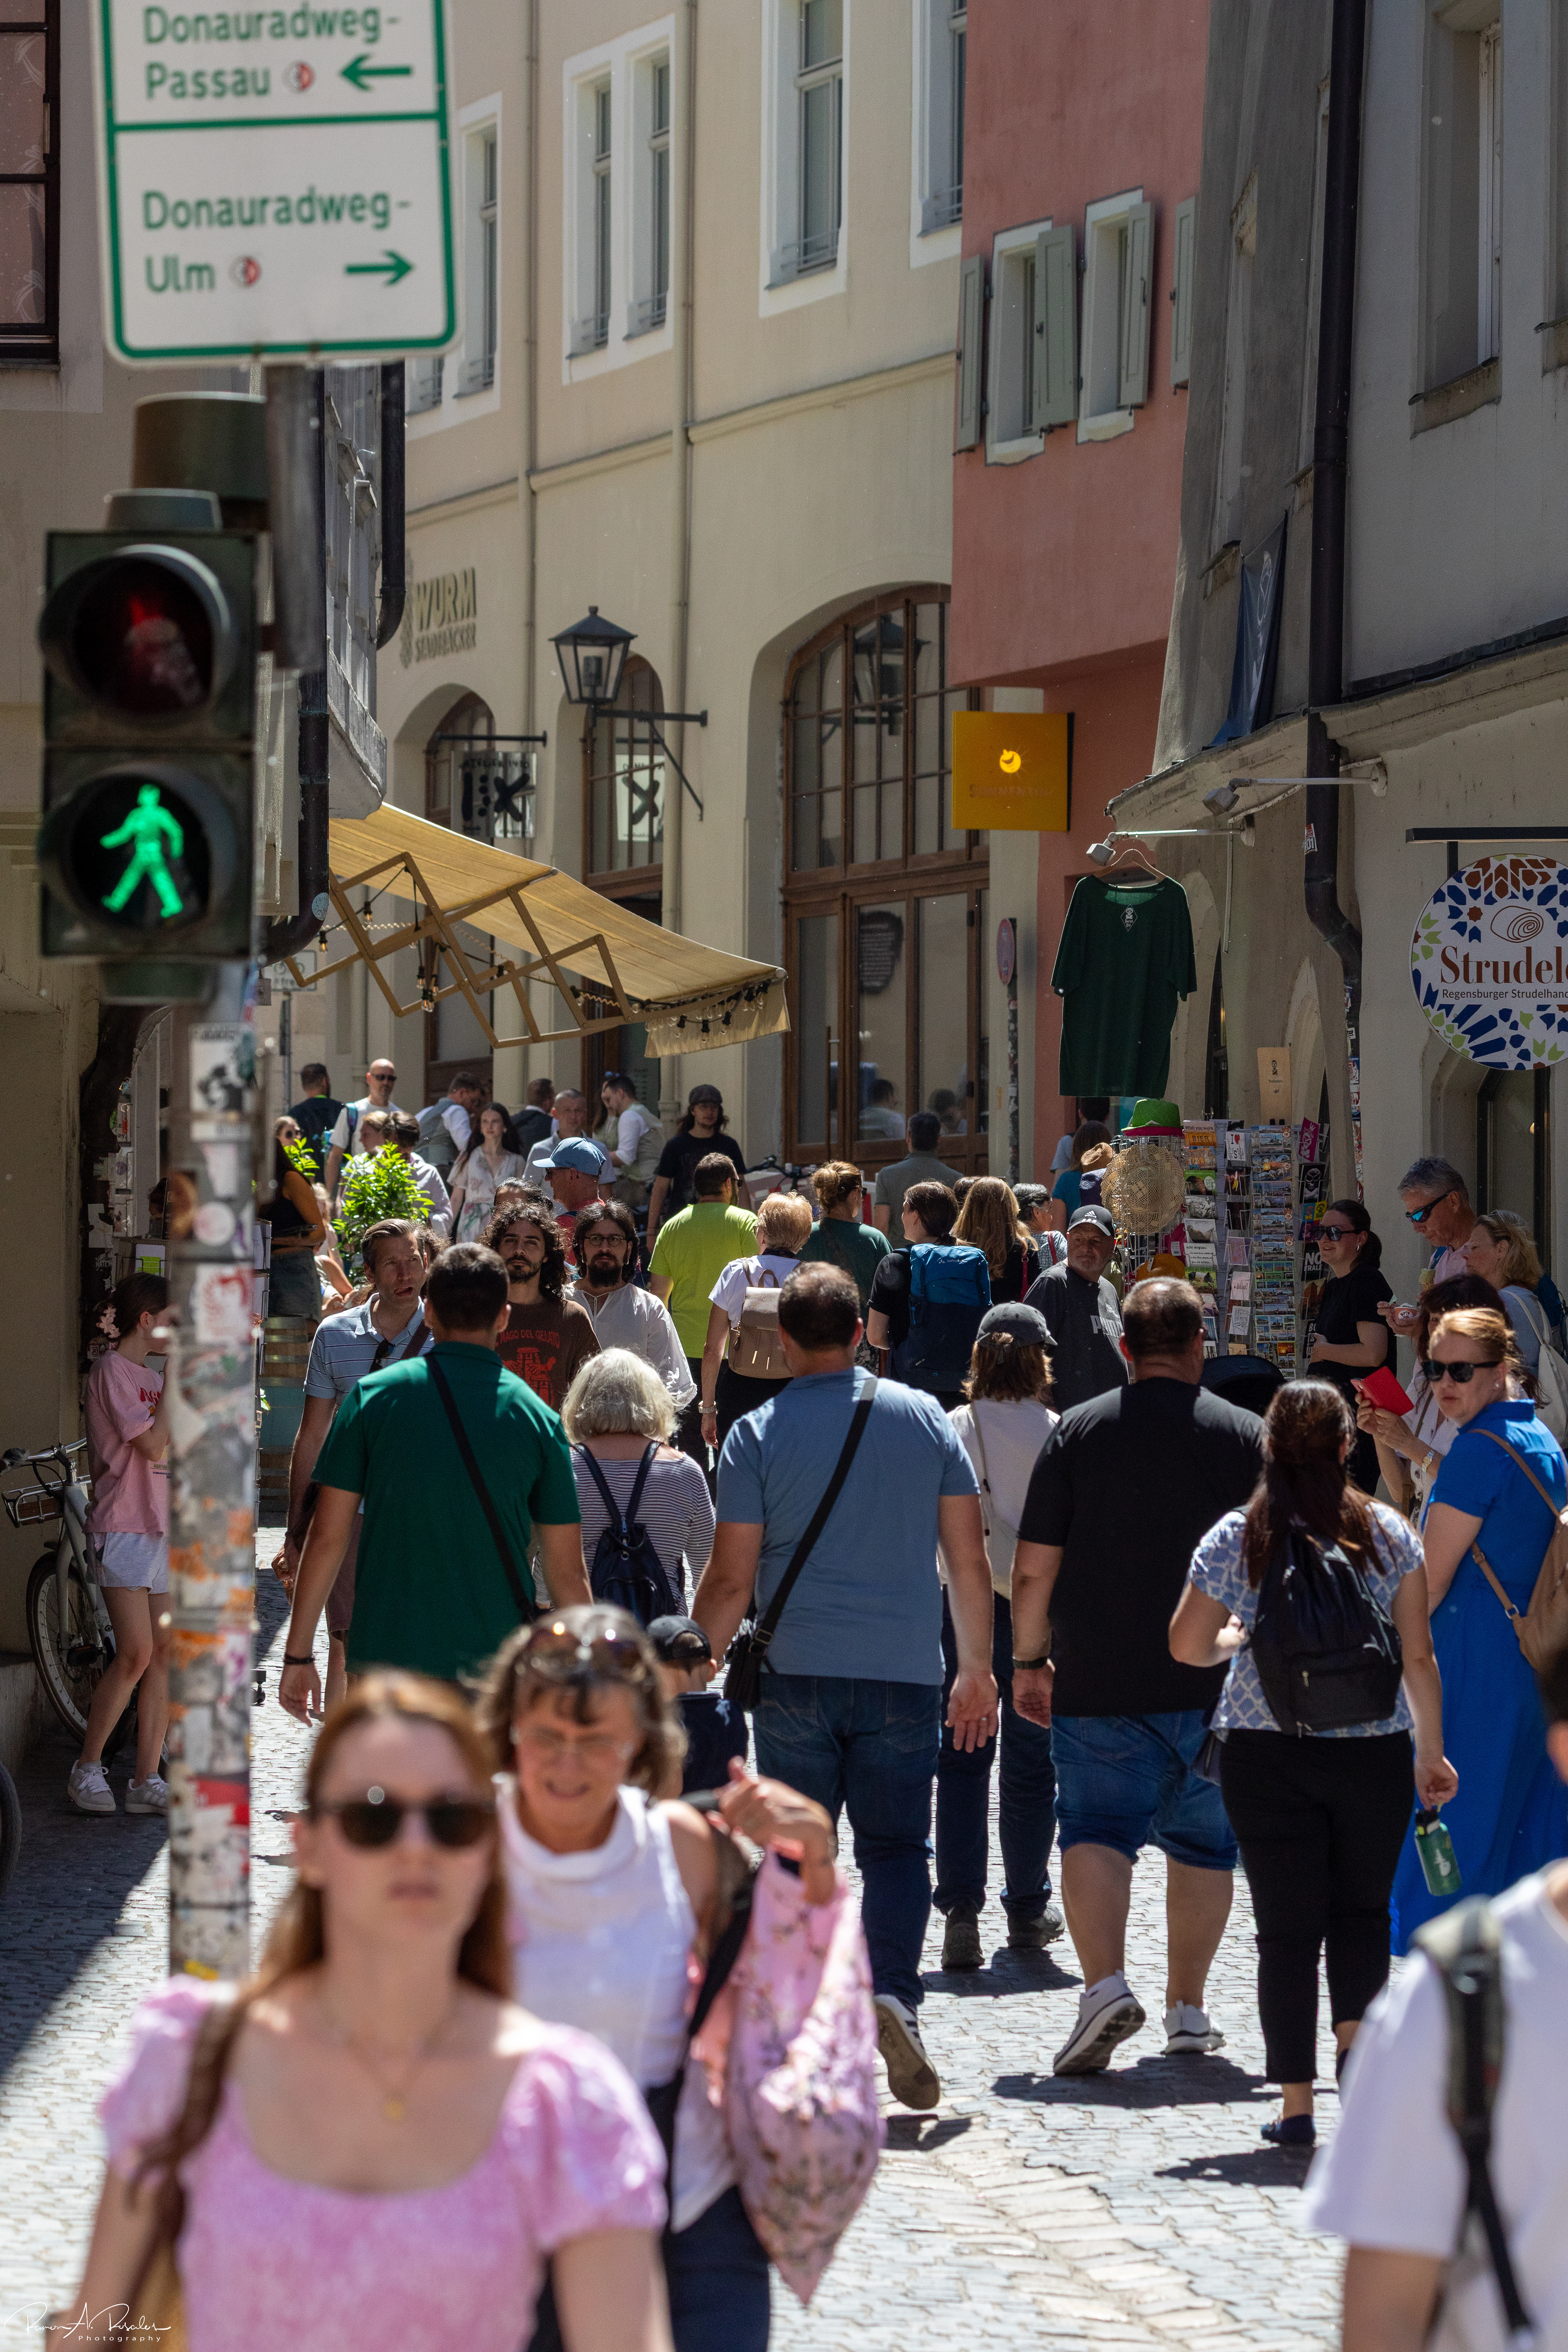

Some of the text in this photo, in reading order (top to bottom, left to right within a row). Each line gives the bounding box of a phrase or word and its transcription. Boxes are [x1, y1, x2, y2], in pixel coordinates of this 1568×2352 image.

[144, 2, 399, 43] Donauradweg-
[146, 62, 271, 100] Passau
[143, 185, 411, 229] Donauradweg-
[145, 255, 216, 293] Ulm
[412, 567, 477, 631] WURM
[1441, 946, 1568, 984] Strudel
[1443, 989, 1508, 1000] Regensburger
[1305, 1252, 1322, 1265] NO
[500, 1330, 560, 1349] MAGO DEL GELATO
